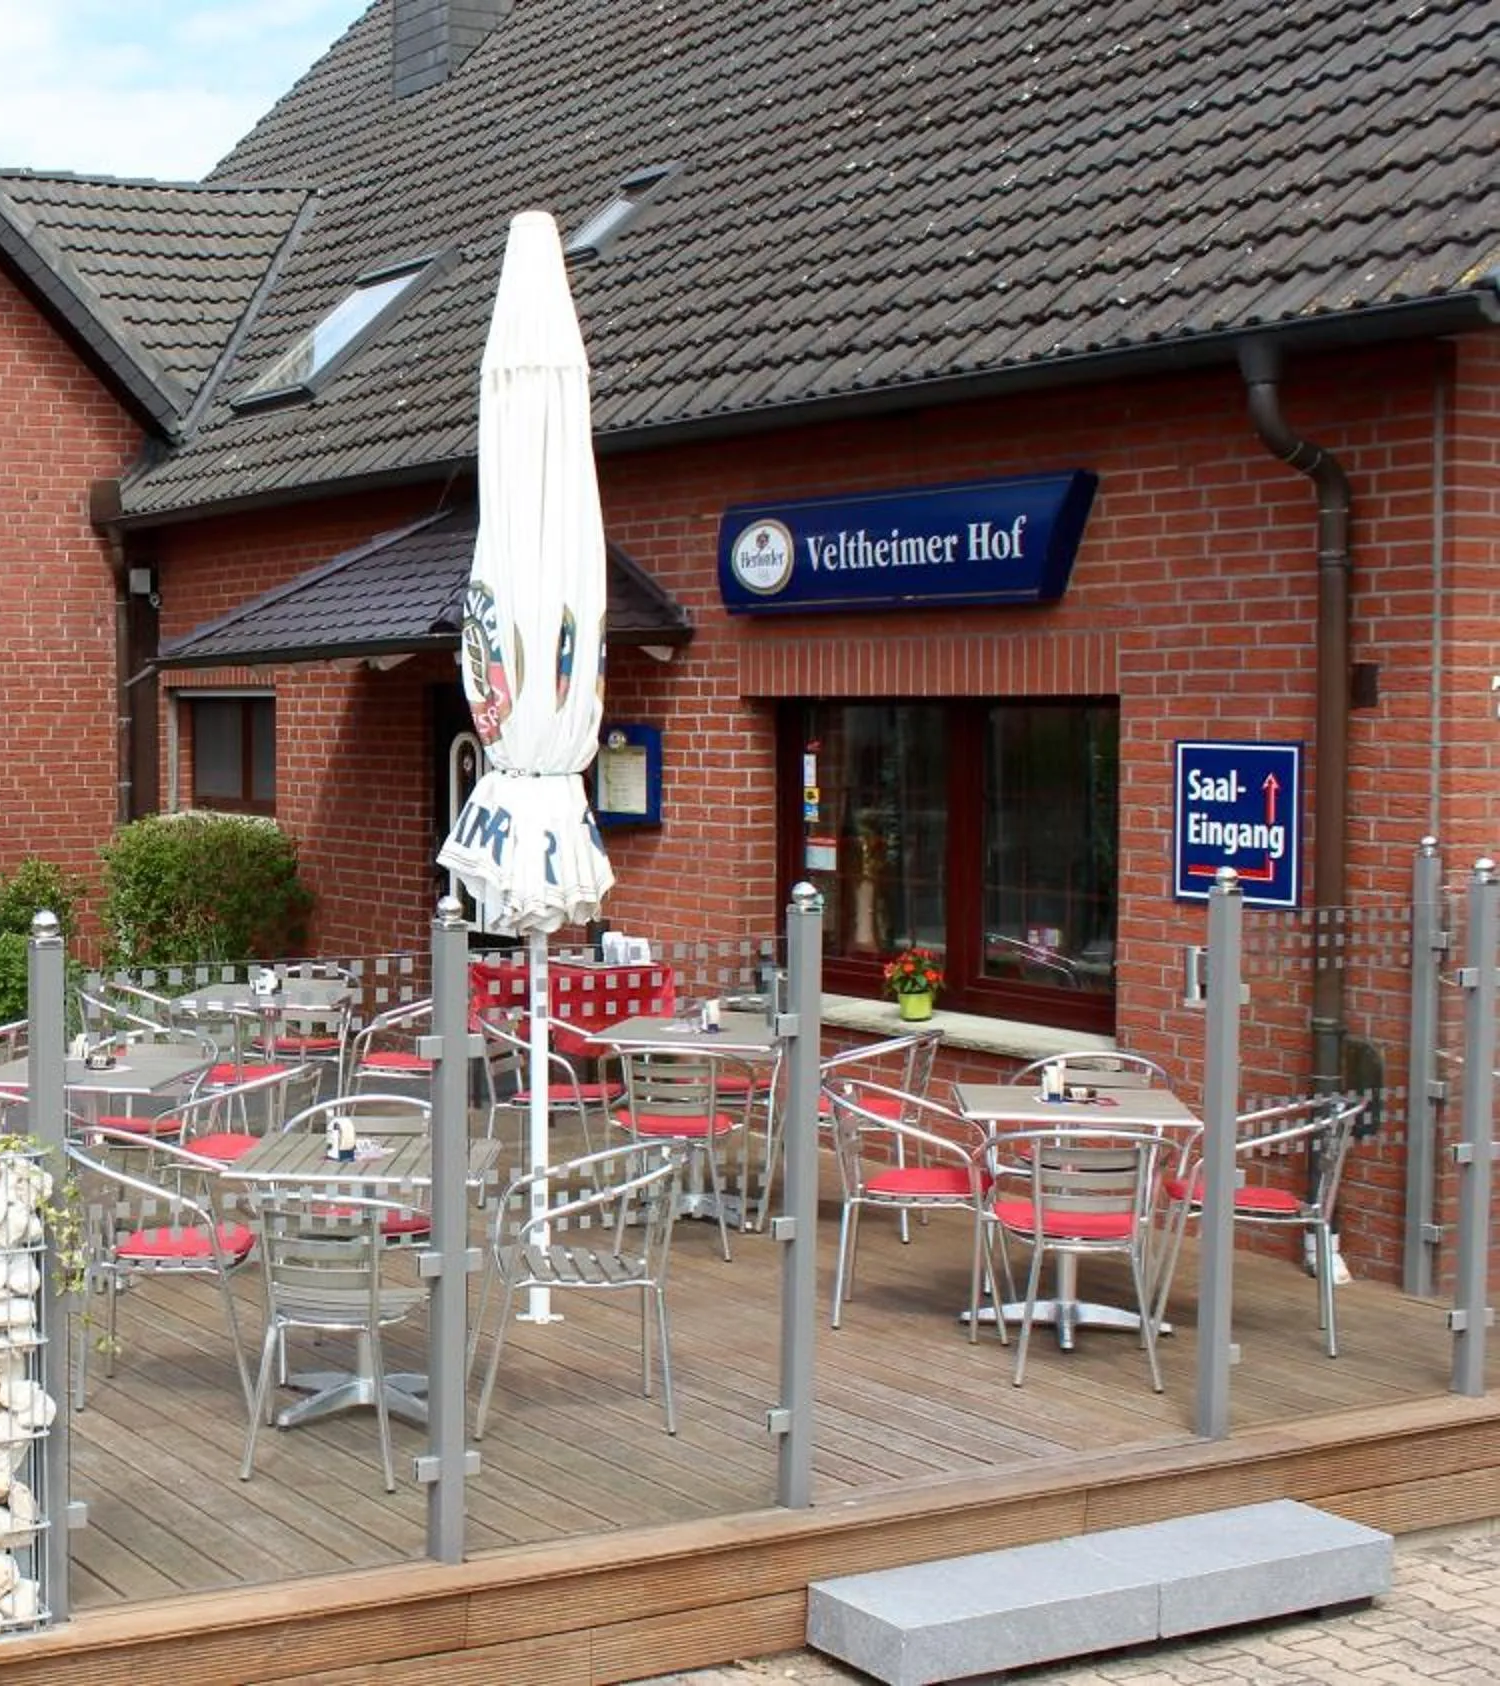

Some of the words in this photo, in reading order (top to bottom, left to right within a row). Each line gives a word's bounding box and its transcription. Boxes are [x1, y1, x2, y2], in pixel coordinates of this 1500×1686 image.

[806, 529, 959, 572] Veltheimer
[967, 514, 1027, 561] Hof
[1187, 768, 1247, 803] Saal-
[1187, 811, 1285, 859] Eingang
